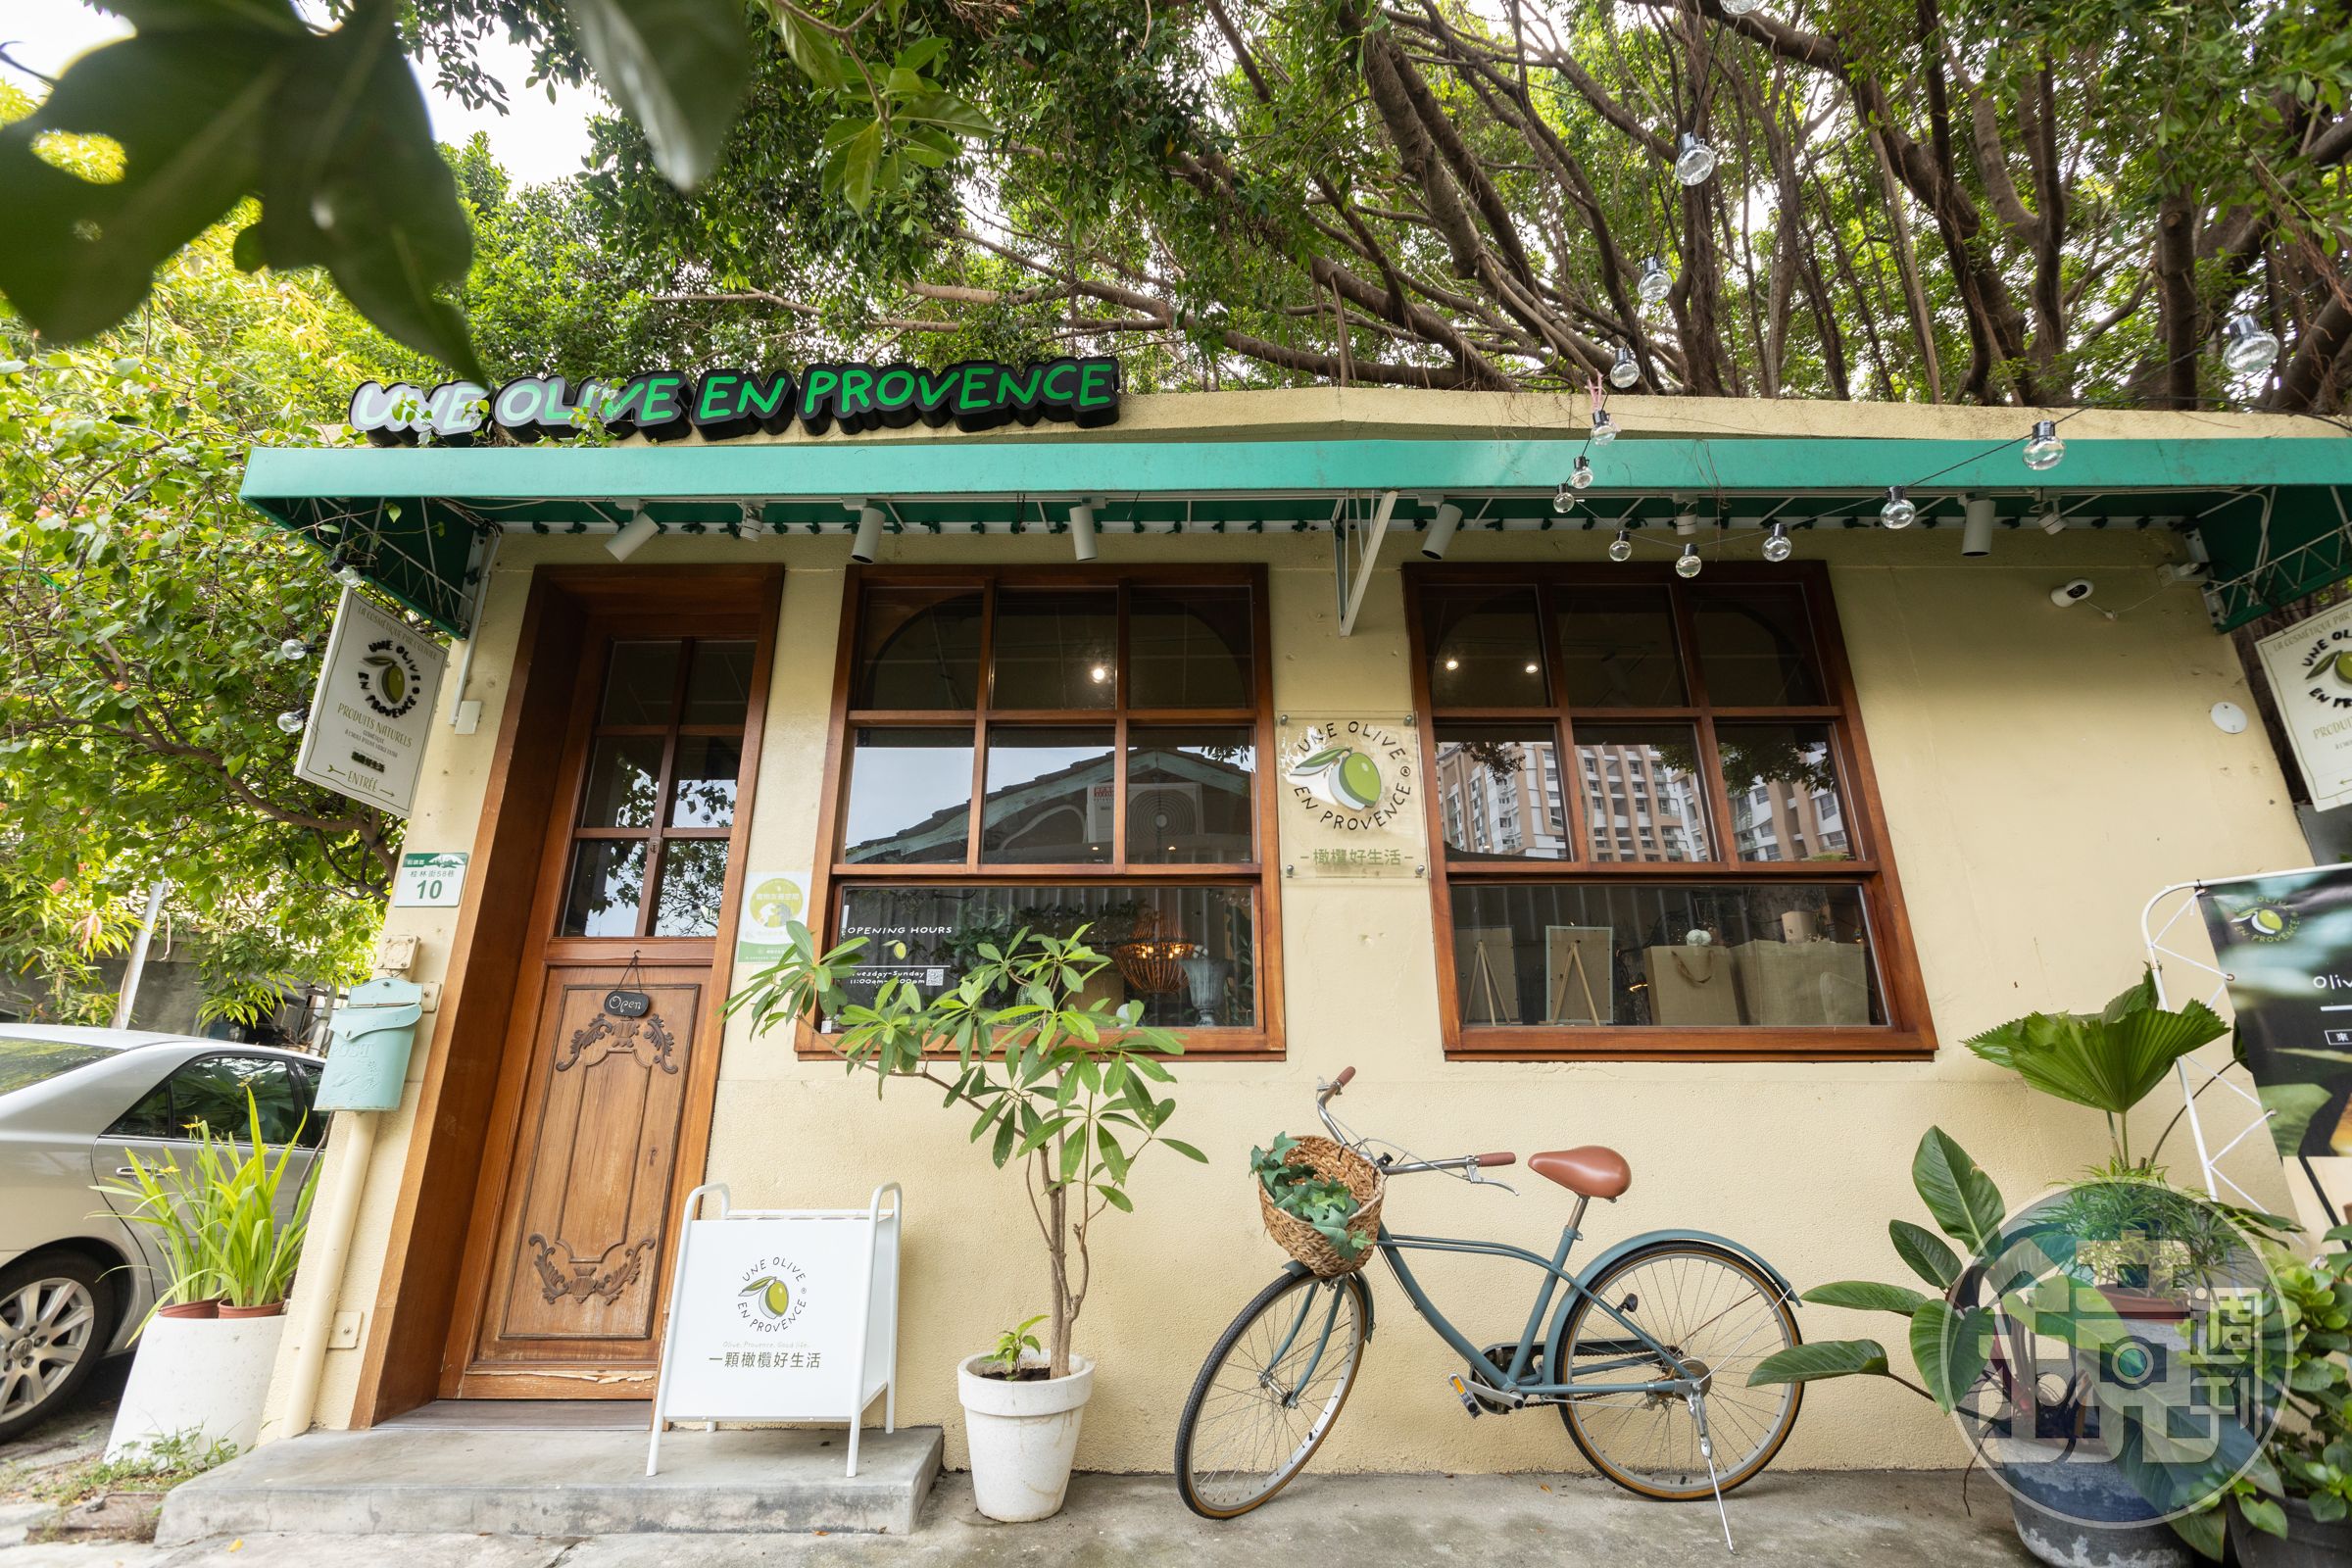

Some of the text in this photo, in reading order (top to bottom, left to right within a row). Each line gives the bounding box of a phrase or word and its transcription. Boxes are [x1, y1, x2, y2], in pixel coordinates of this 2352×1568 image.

[359, 386, 488, 429] UNE
[700, 375, 786, 417] EN
[804, 364, 1113, 414] PROVENCE
[368, 639, 421, 681] UNE OLIVE
[2301, 638, 2329, 666] UNE
[365, 695, 417, 718] PROVENCE
[2308, 687, 2331, 703] EN
[337, 702, 375, 730] PRODUITS
[375, 721, 413, 748] NATURELS
[2313, 715, 2352, 740] PRODUI
[1298, 720, 1406, 760] UNE OLIVE
[1294, 783, 1411, 831] EN PROVENCE
[1313, 849, 1401, 866] 橄欖好生活
[416, 879, 443, 900] 10
[848, 926, 906, 935] OPENING
[2234, 919, 2300, 943] EN PROVENCE
[609, 995, 642, 1013] Open
[328, 1043, 375, 1058] POST
[742, 1256, 806, 1283] UNE OLIVE
[737, 1298, 807, 1333] EN PROVENCE
[709, 1351, 821, 1369] 一顆橄欖好生活
